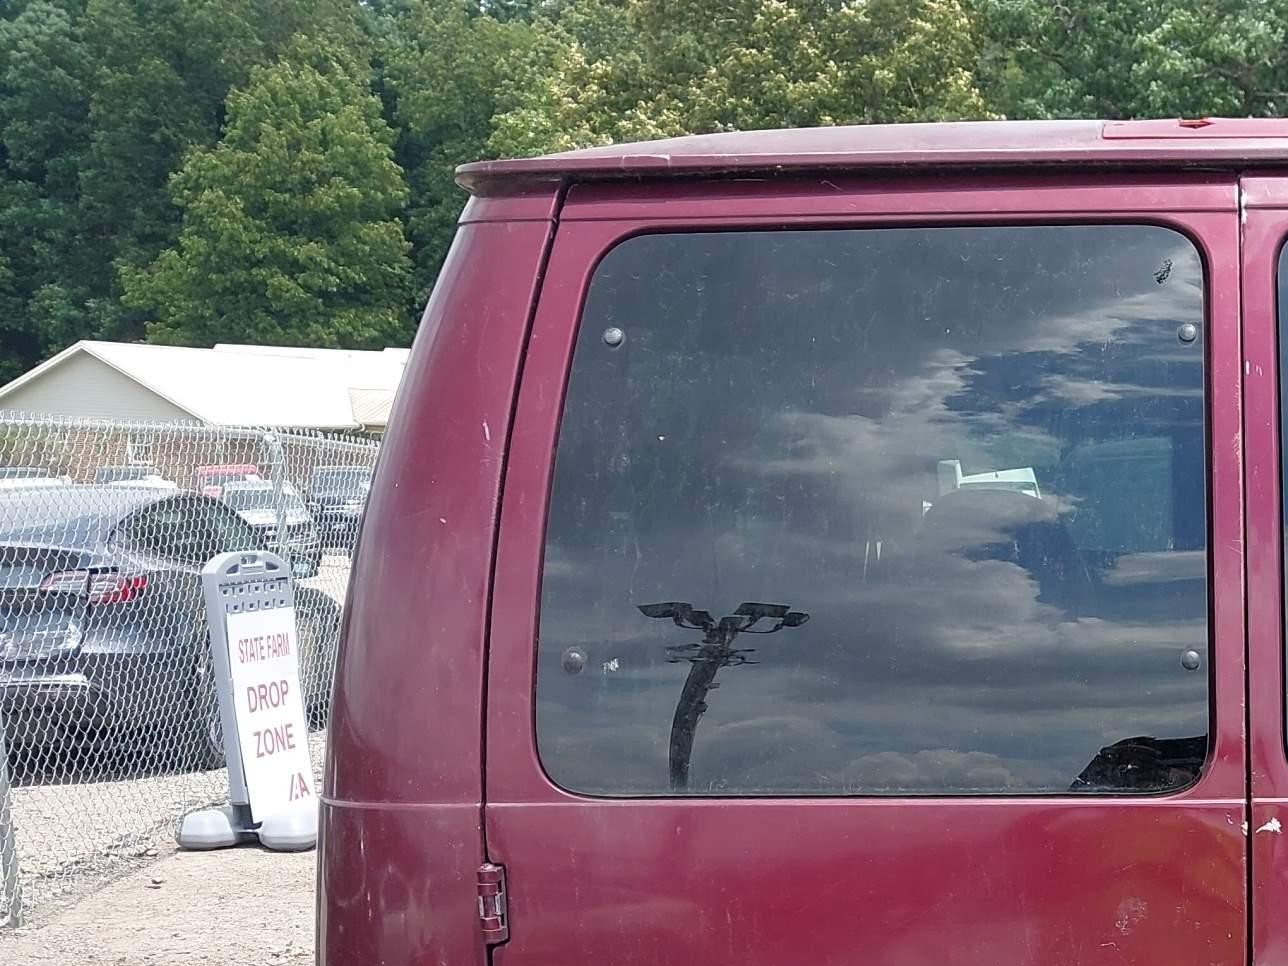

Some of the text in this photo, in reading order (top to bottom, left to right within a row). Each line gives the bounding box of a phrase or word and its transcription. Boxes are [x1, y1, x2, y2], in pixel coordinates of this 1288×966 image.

[238, 632, 291, 664] STATE FARM
[247, 680, 289, 713] DROP
[253, 723, 296, 758] ZONE
